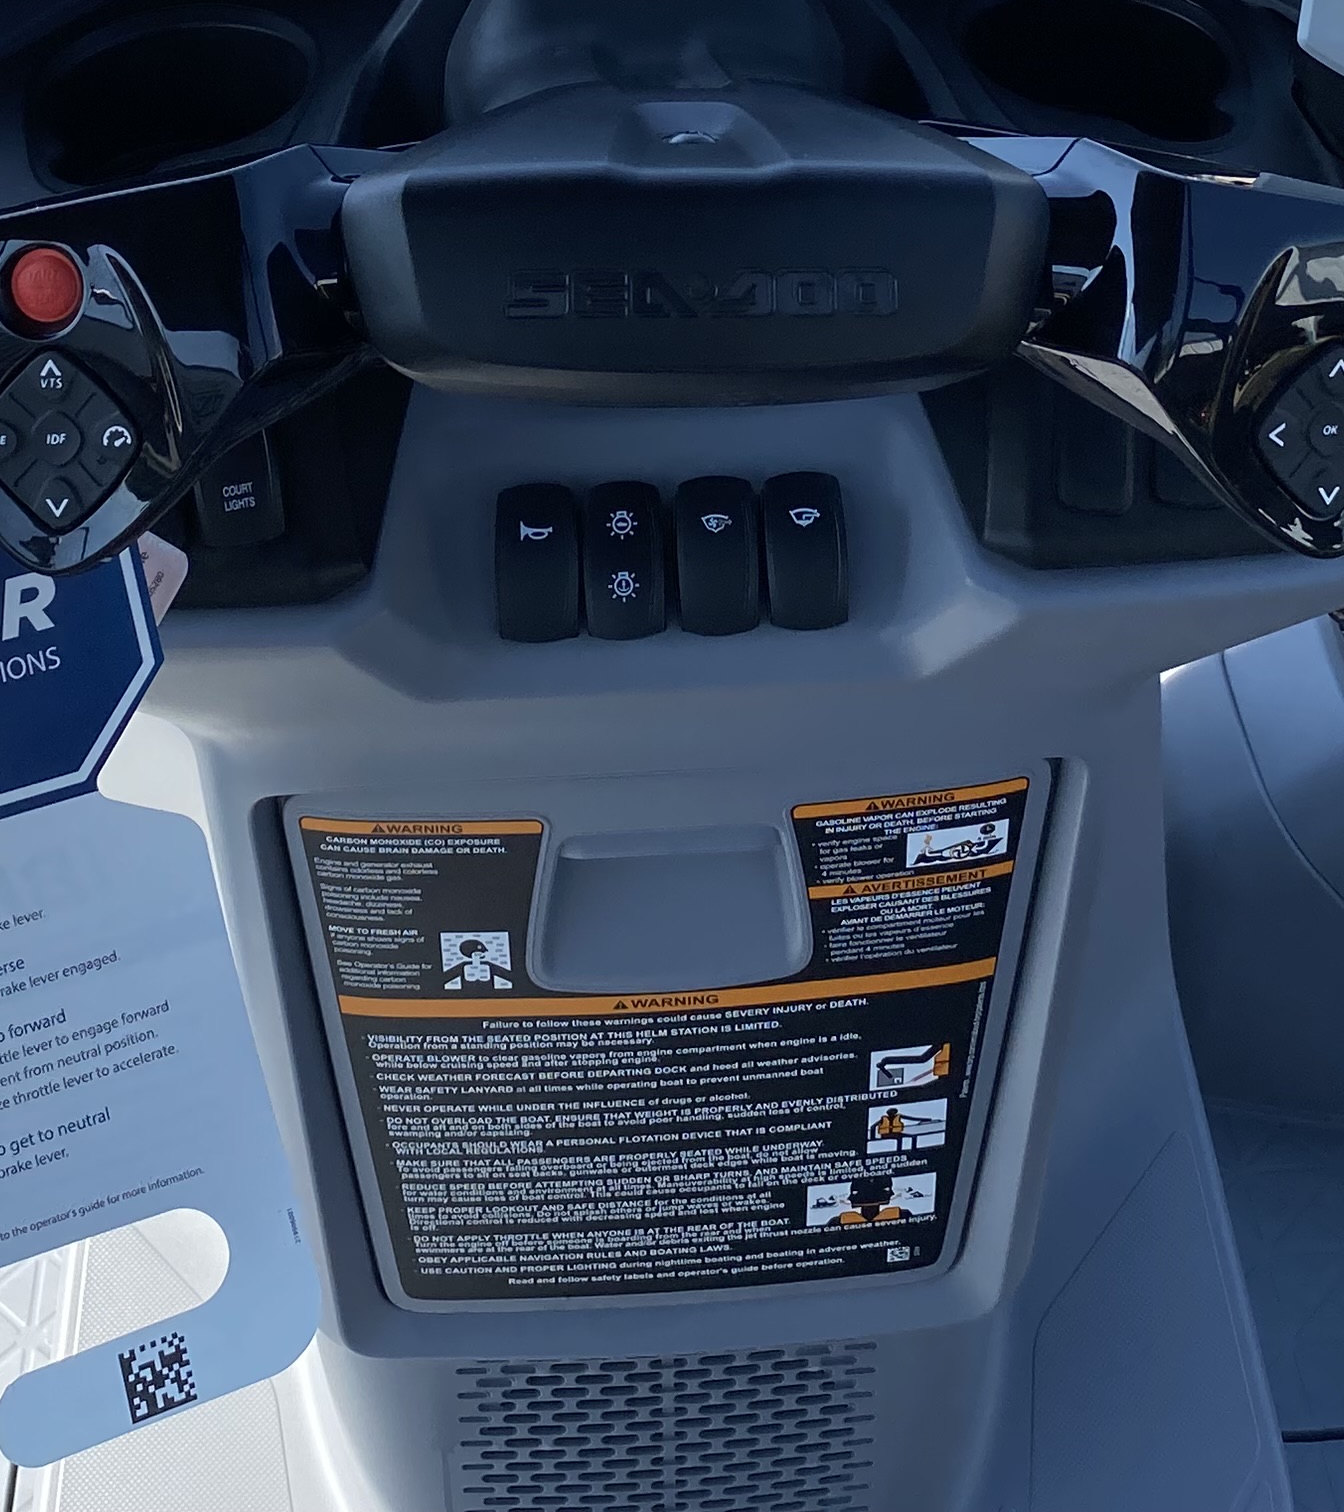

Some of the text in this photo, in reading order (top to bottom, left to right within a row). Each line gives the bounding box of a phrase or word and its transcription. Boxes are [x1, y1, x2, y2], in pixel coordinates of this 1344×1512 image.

[46, 433, 67, 445] IDF
[1322, 424, 1339, 436] OK
[222, 482, 254, 498] COURT
[224, 496, 256, 513] LIGHTS
[881, 792, 955, 809] WARNING
[387, 824, 463, 834] WARNING
[861, 869, 988, 893] AVERTISSEMENT
[12, 909, 43, 926] lever.
[28, 970, 58, 987] lever
[62, 949, 120, 977] engaged.
[631, 995, 720, 1009] WARNING
[7, 1007, 66, 1038] forward
[21, 1039, 51, 1057] lever
[54, 1035, 69, 1046] to
[71, 1018, 118, 1040] engage
[120, 999, 169, 1025] forward
[23, 1062, 54, 1079] from
[56, 1043, 101, 1068] neutral
[104, 1029, 157, 1056] position.
[12, 1081, 60, 1105] throttle
[62, 1071, 93, 1089] lever
[95, 1066, 109, 1078] to
[112, 1045, 175, 1073] accelerate.
[9, 1133, 35, 1155] get
[37, 1129, 53, 1142] to
[57, 1106, 110, 1136] neutral
[34, 1148, 68, 1166] lever.
[0, 1232, 10, 1241] to
[11, 1226, 27, 1237] the
[29, 1208, 77, 1231] operator's
[78, 1199, 105, 1217] guide
[106, 1194, 119, 1205] for
[121, 1186, 146, 1200] more
